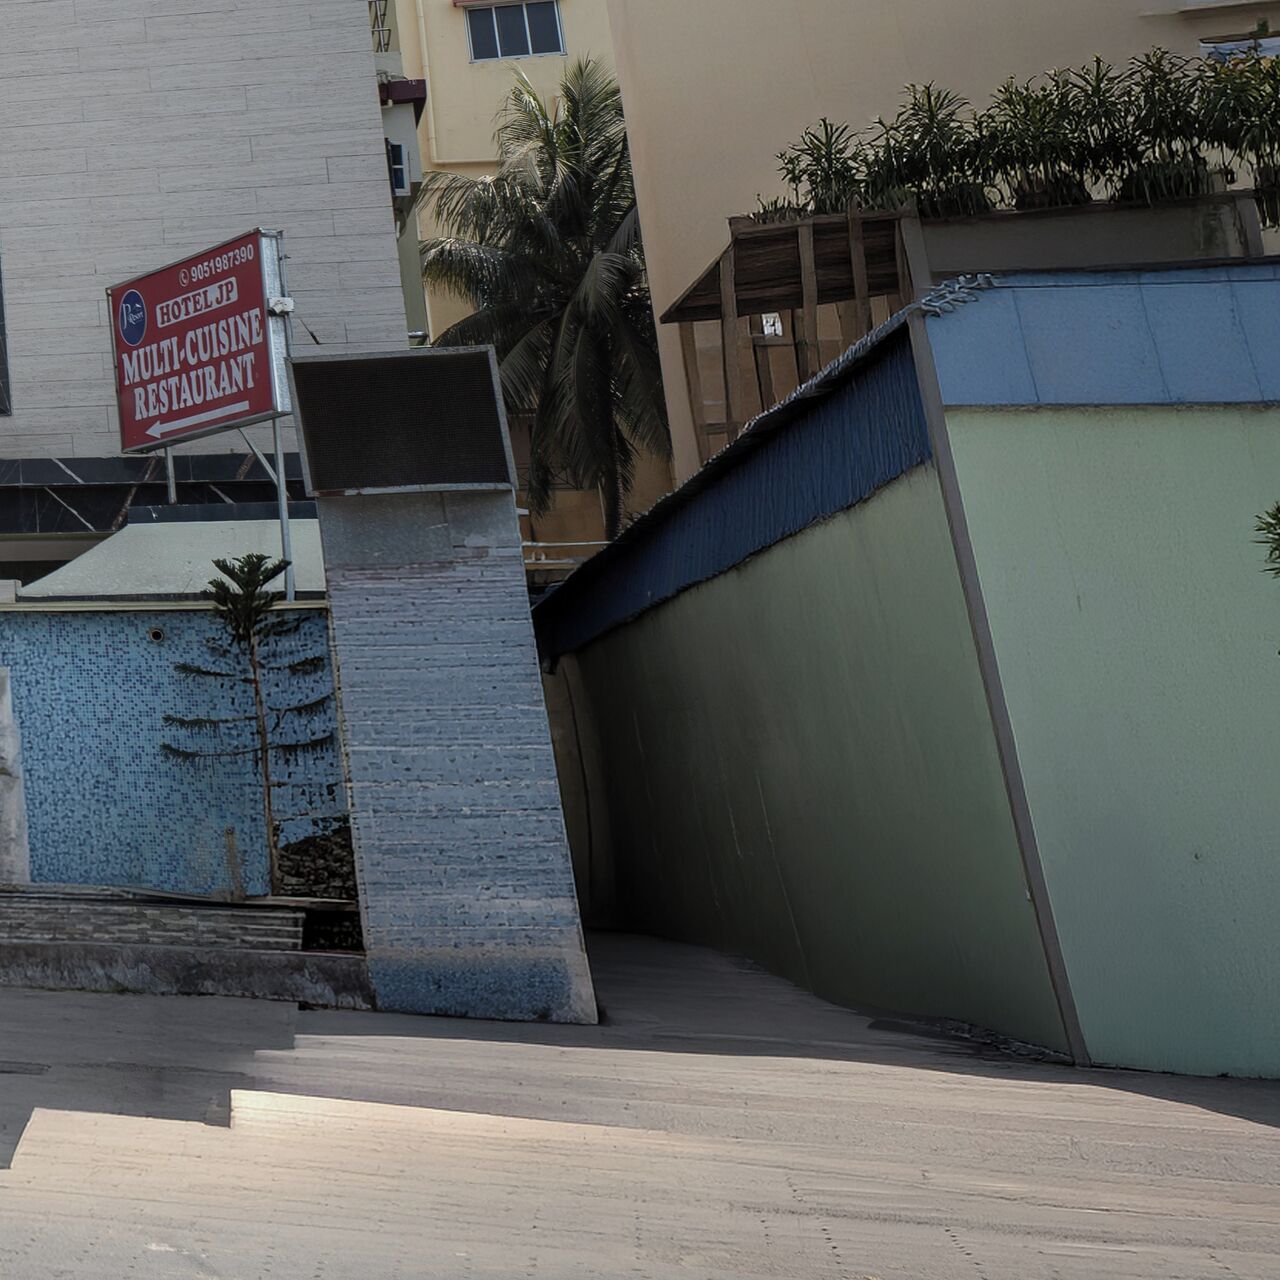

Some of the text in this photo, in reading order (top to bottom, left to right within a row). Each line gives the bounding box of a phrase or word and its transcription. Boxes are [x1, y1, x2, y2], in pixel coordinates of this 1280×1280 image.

[191, 243, 255, 282] 9051987390
[159, 279, 236, 325] HOTEL JP
[122, 307, 264, 386] MULTI-CUISINE
[134, 352, 256, 421] RESTAURANT
